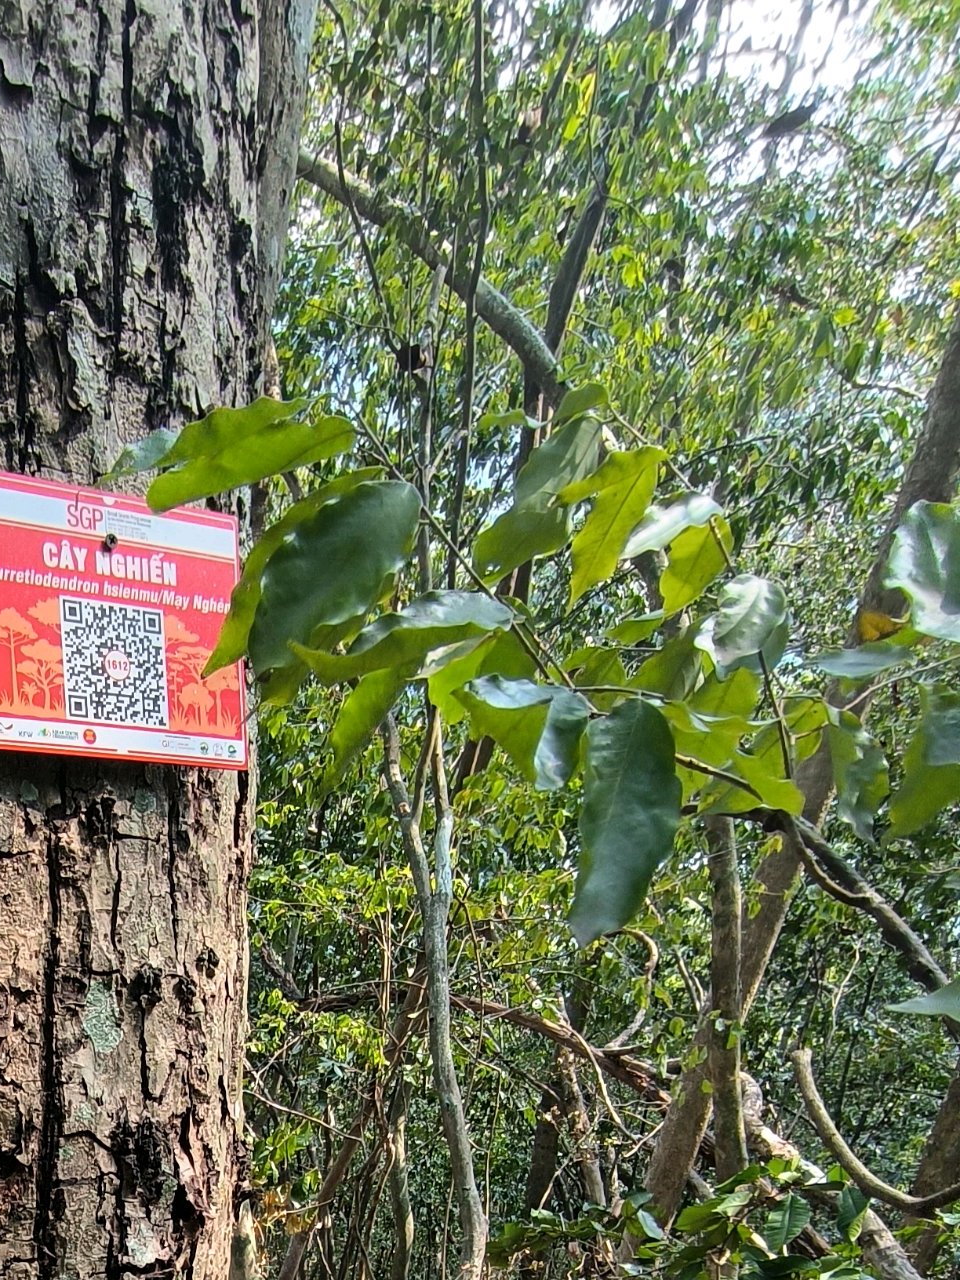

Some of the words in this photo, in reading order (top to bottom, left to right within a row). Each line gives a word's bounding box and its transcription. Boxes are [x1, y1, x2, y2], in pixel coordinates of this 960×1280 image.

[67, 504, 104, 531] SGP
[42, 540, 88, 572] CÂY
[95, 553, 177, 586] NGHIẾN
[107, 659, 128, 671] 1612
